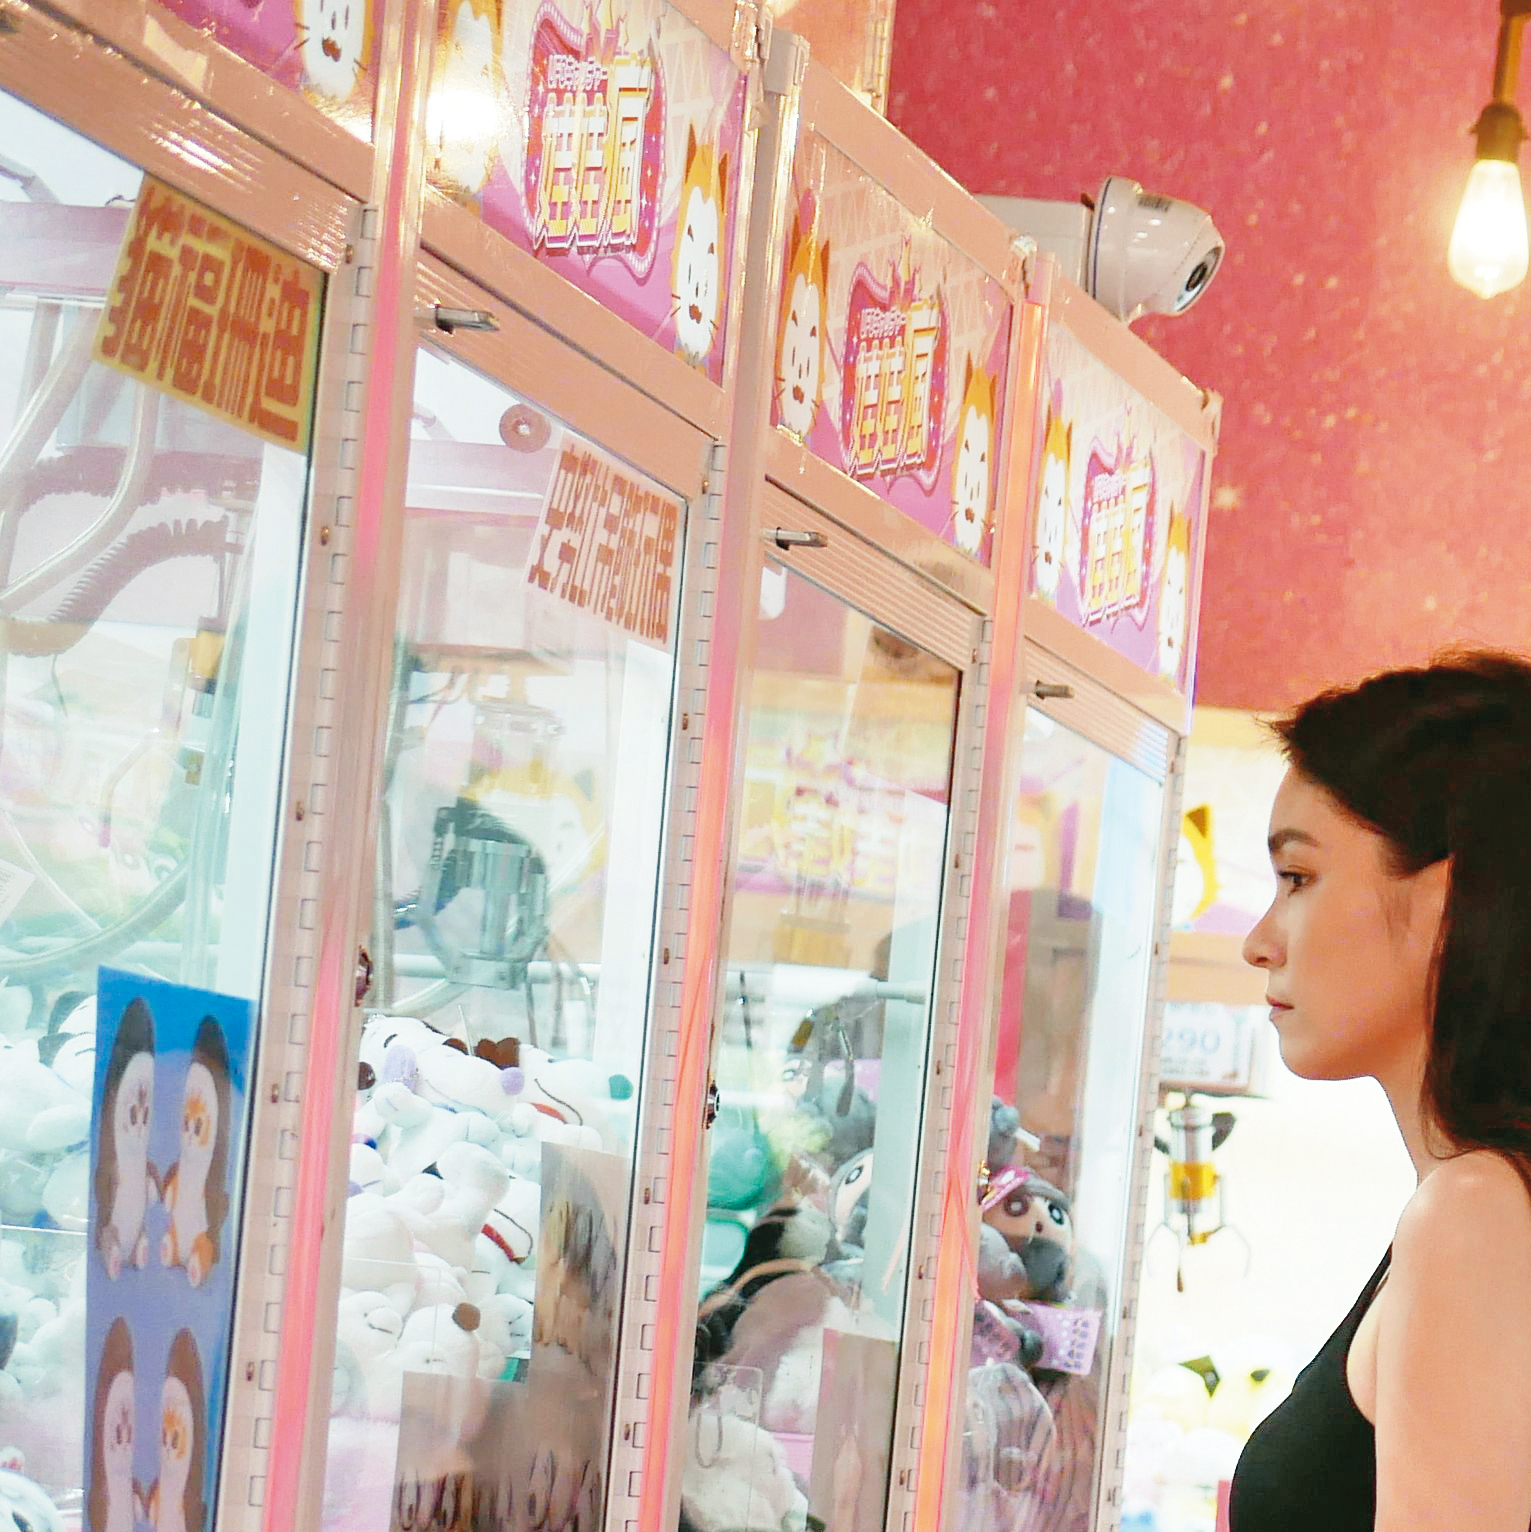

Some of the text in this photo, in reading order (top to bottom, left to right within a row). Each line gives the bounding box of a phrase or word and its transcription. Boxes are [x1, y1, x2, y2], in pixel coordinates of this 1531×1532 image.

[101, 186, 311, 442] 貓福珊迪
[528, 444, 679, 645] 史努比吊飾玩偶
